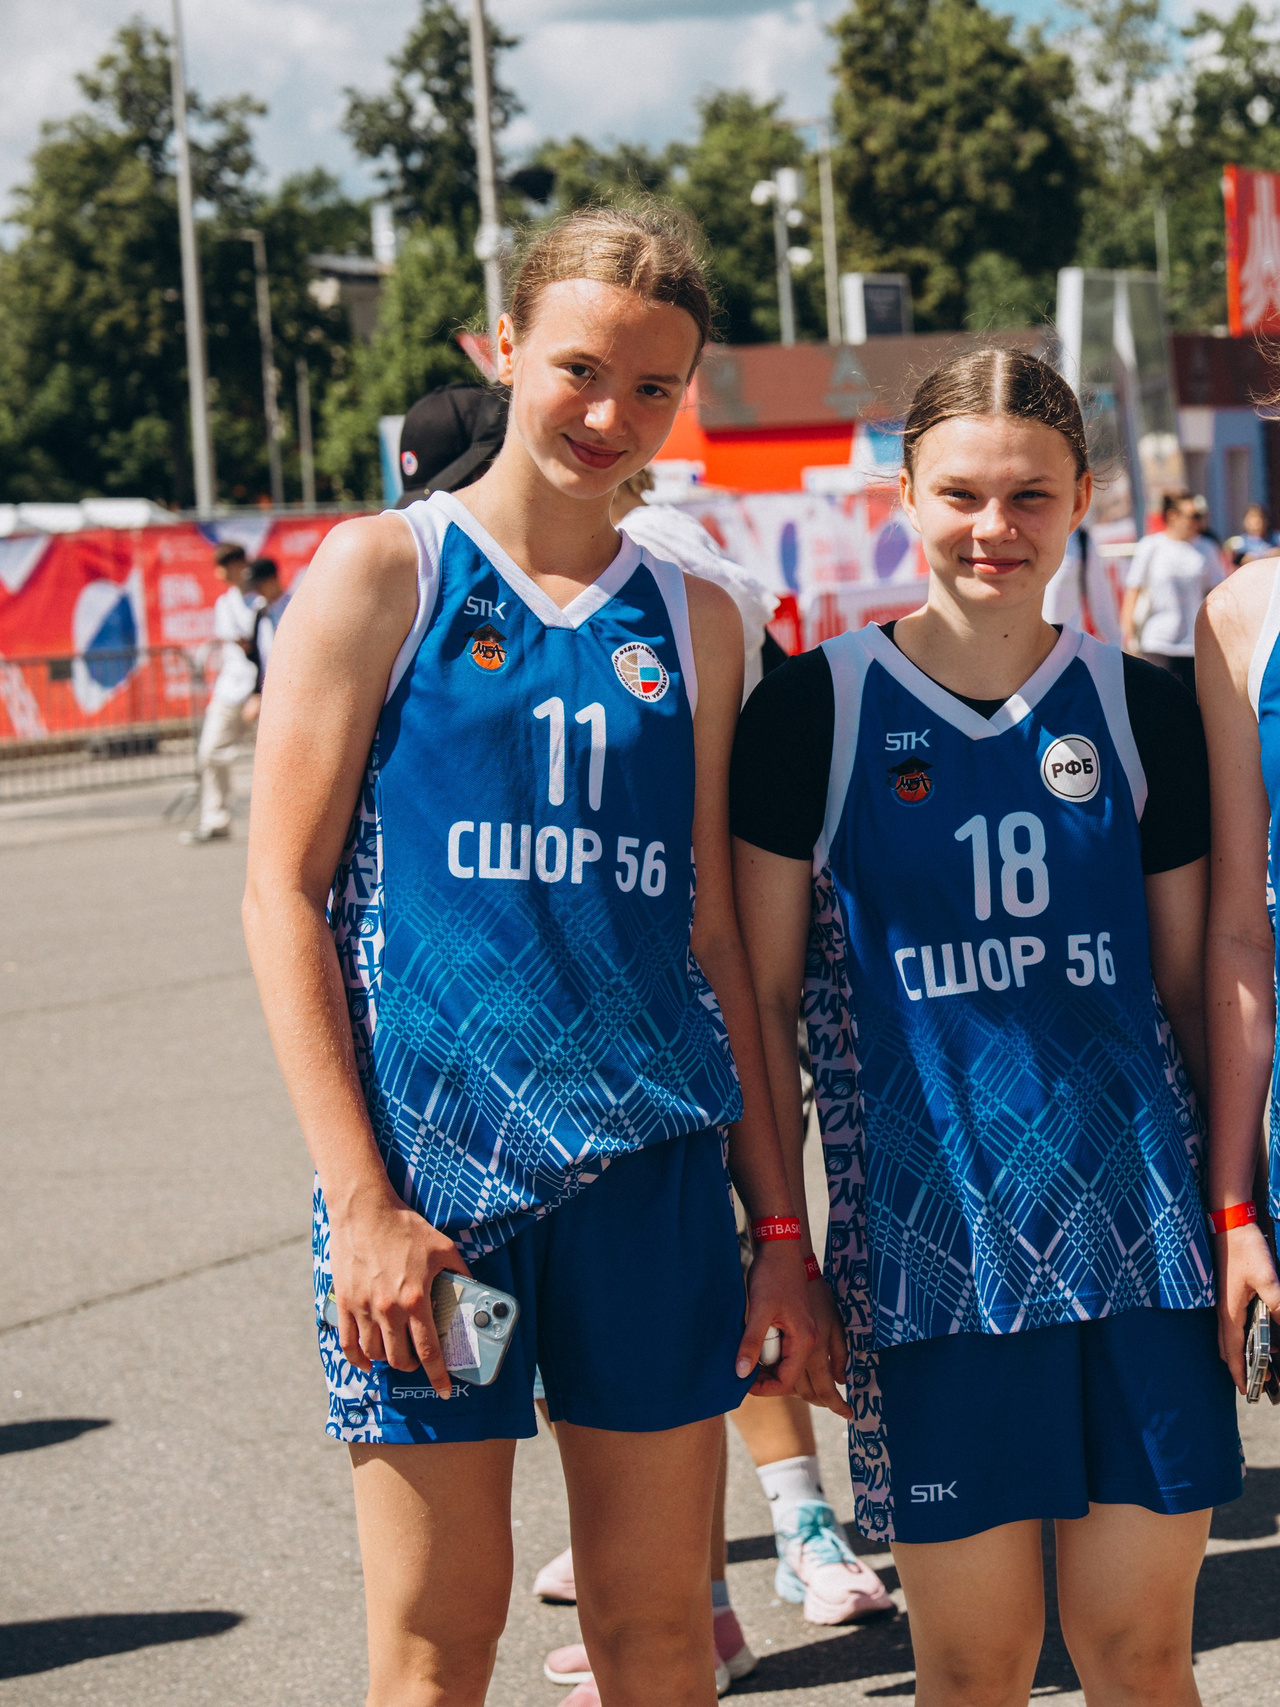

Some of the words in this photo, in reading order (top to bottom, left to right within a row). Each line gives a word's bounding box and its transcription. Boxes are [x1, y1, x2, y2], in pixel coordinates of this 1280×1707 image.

[463, 595, 506, 620] STK
[884, 729, 931, 751] STK
[533, 696, 606, 811] 11
[1051, 757, 1094, 779] РФБ
[447, 820, 602, 884] СШОР
[615, 836, 667, 897] 56
[954, 811, 1050, 921] 18
[894, 935, 1046, 1001] СШОР
[1066, 932, 1116, 986] 56
[392, 1384, 469, 1399] SPOREK
[911, 1480, 958, 1503] STK
